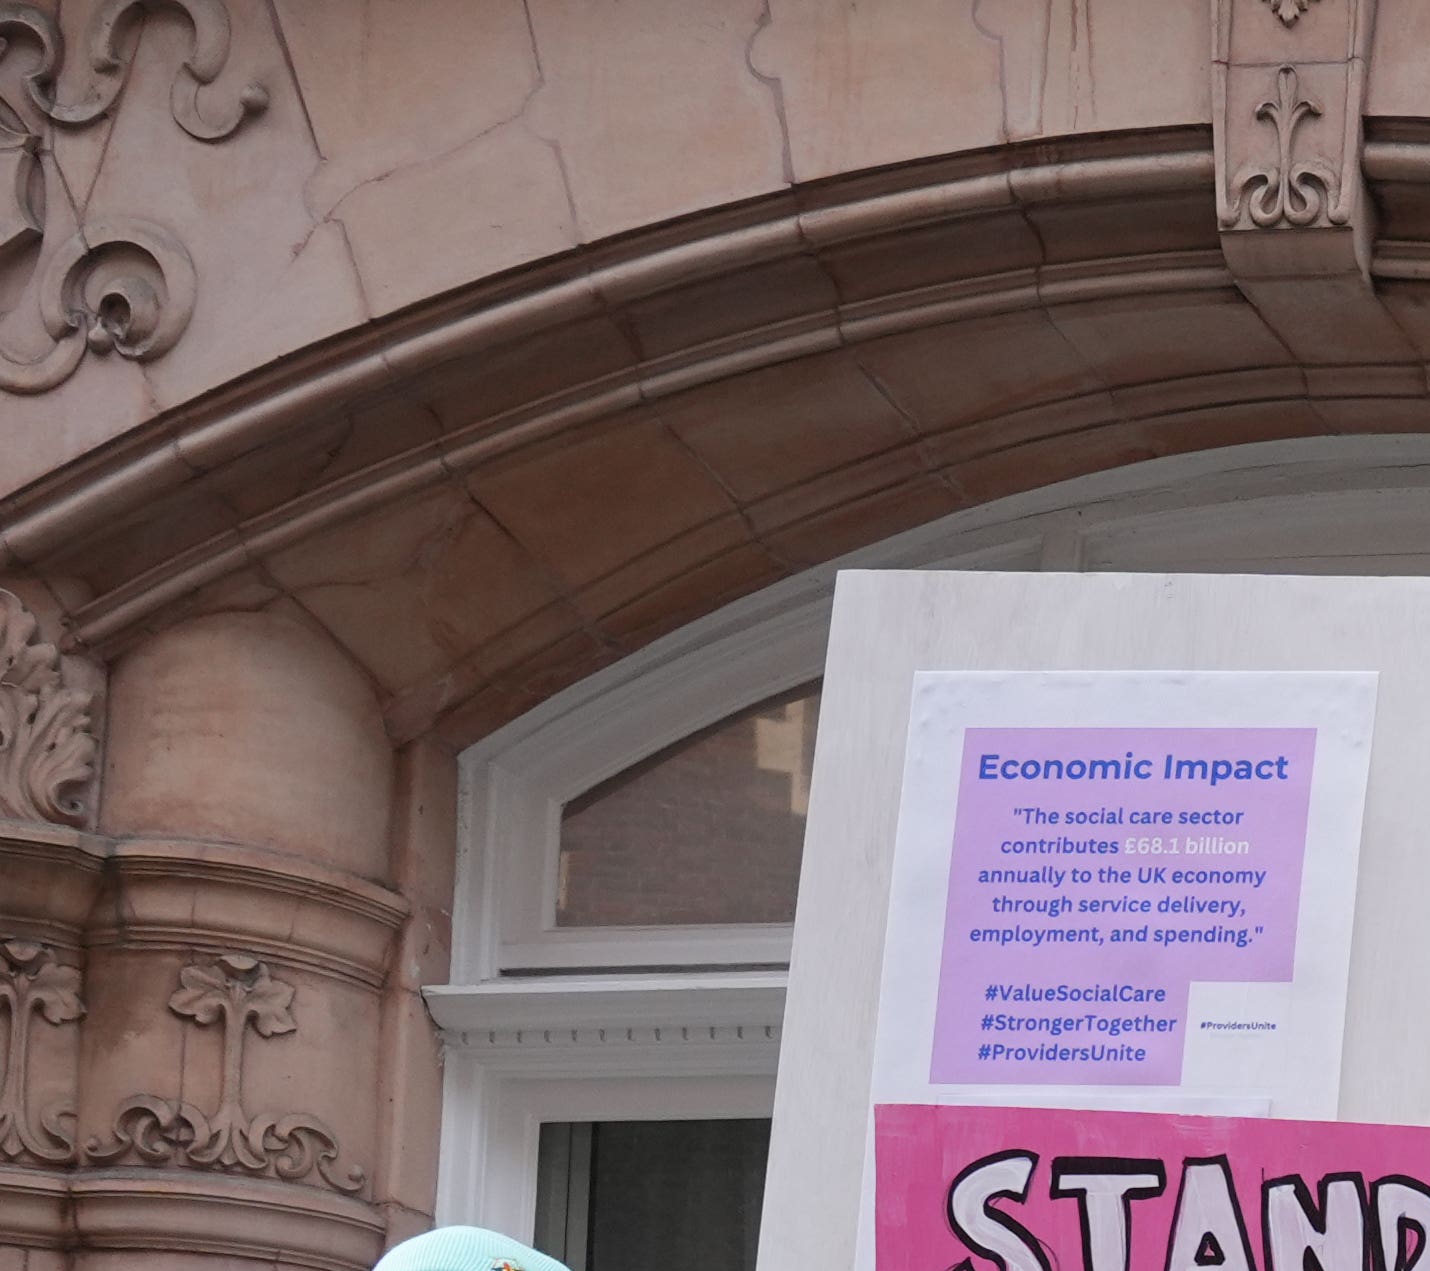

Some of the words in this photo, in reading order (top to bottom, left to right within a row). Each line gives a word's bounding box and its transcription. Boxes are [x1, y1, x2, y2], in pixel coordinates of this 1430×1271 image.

[978, 751, 1153, 780] Economic
[1163, 754, 1289, 786] Impact
[1013, 807, 1060, 825] "The
[1064, 807, 1123, 825] social
[1129, 811, 1172, 825] care
[1178, 810, 1245, 825] sector
[1000, 837, 1119, 854] contributes
[1124, 836, 1180, 855] £68.1
[1185, 836, 1250, 855] billion
[978, 866, 1065, 888] annually
[1071, 869, 1092, 883] to
[1098, 867, 1132, 883] the
[1137, 867, 1168, 883] UK
[1171, 870, 1267, 888] economy
[992, 896, 1073, 917] through
[1078, 897, 1151, 913] service
[1157, 896, 1246, 917] delivery,
[970, 926, 1104, 946] employment,
[1110, 926, 1148, 942] and
[1153, 926, 1264, 947] spending."
[985, 983, 1166, 1004] #ValueSocialCare
[980, 1012, 1177, 1037] #StrongerTogether
[1200, 1021, 1277, 1031] #ProvidersUnite
[977, 1042, 1147, 1063] #ProvidersUnite
